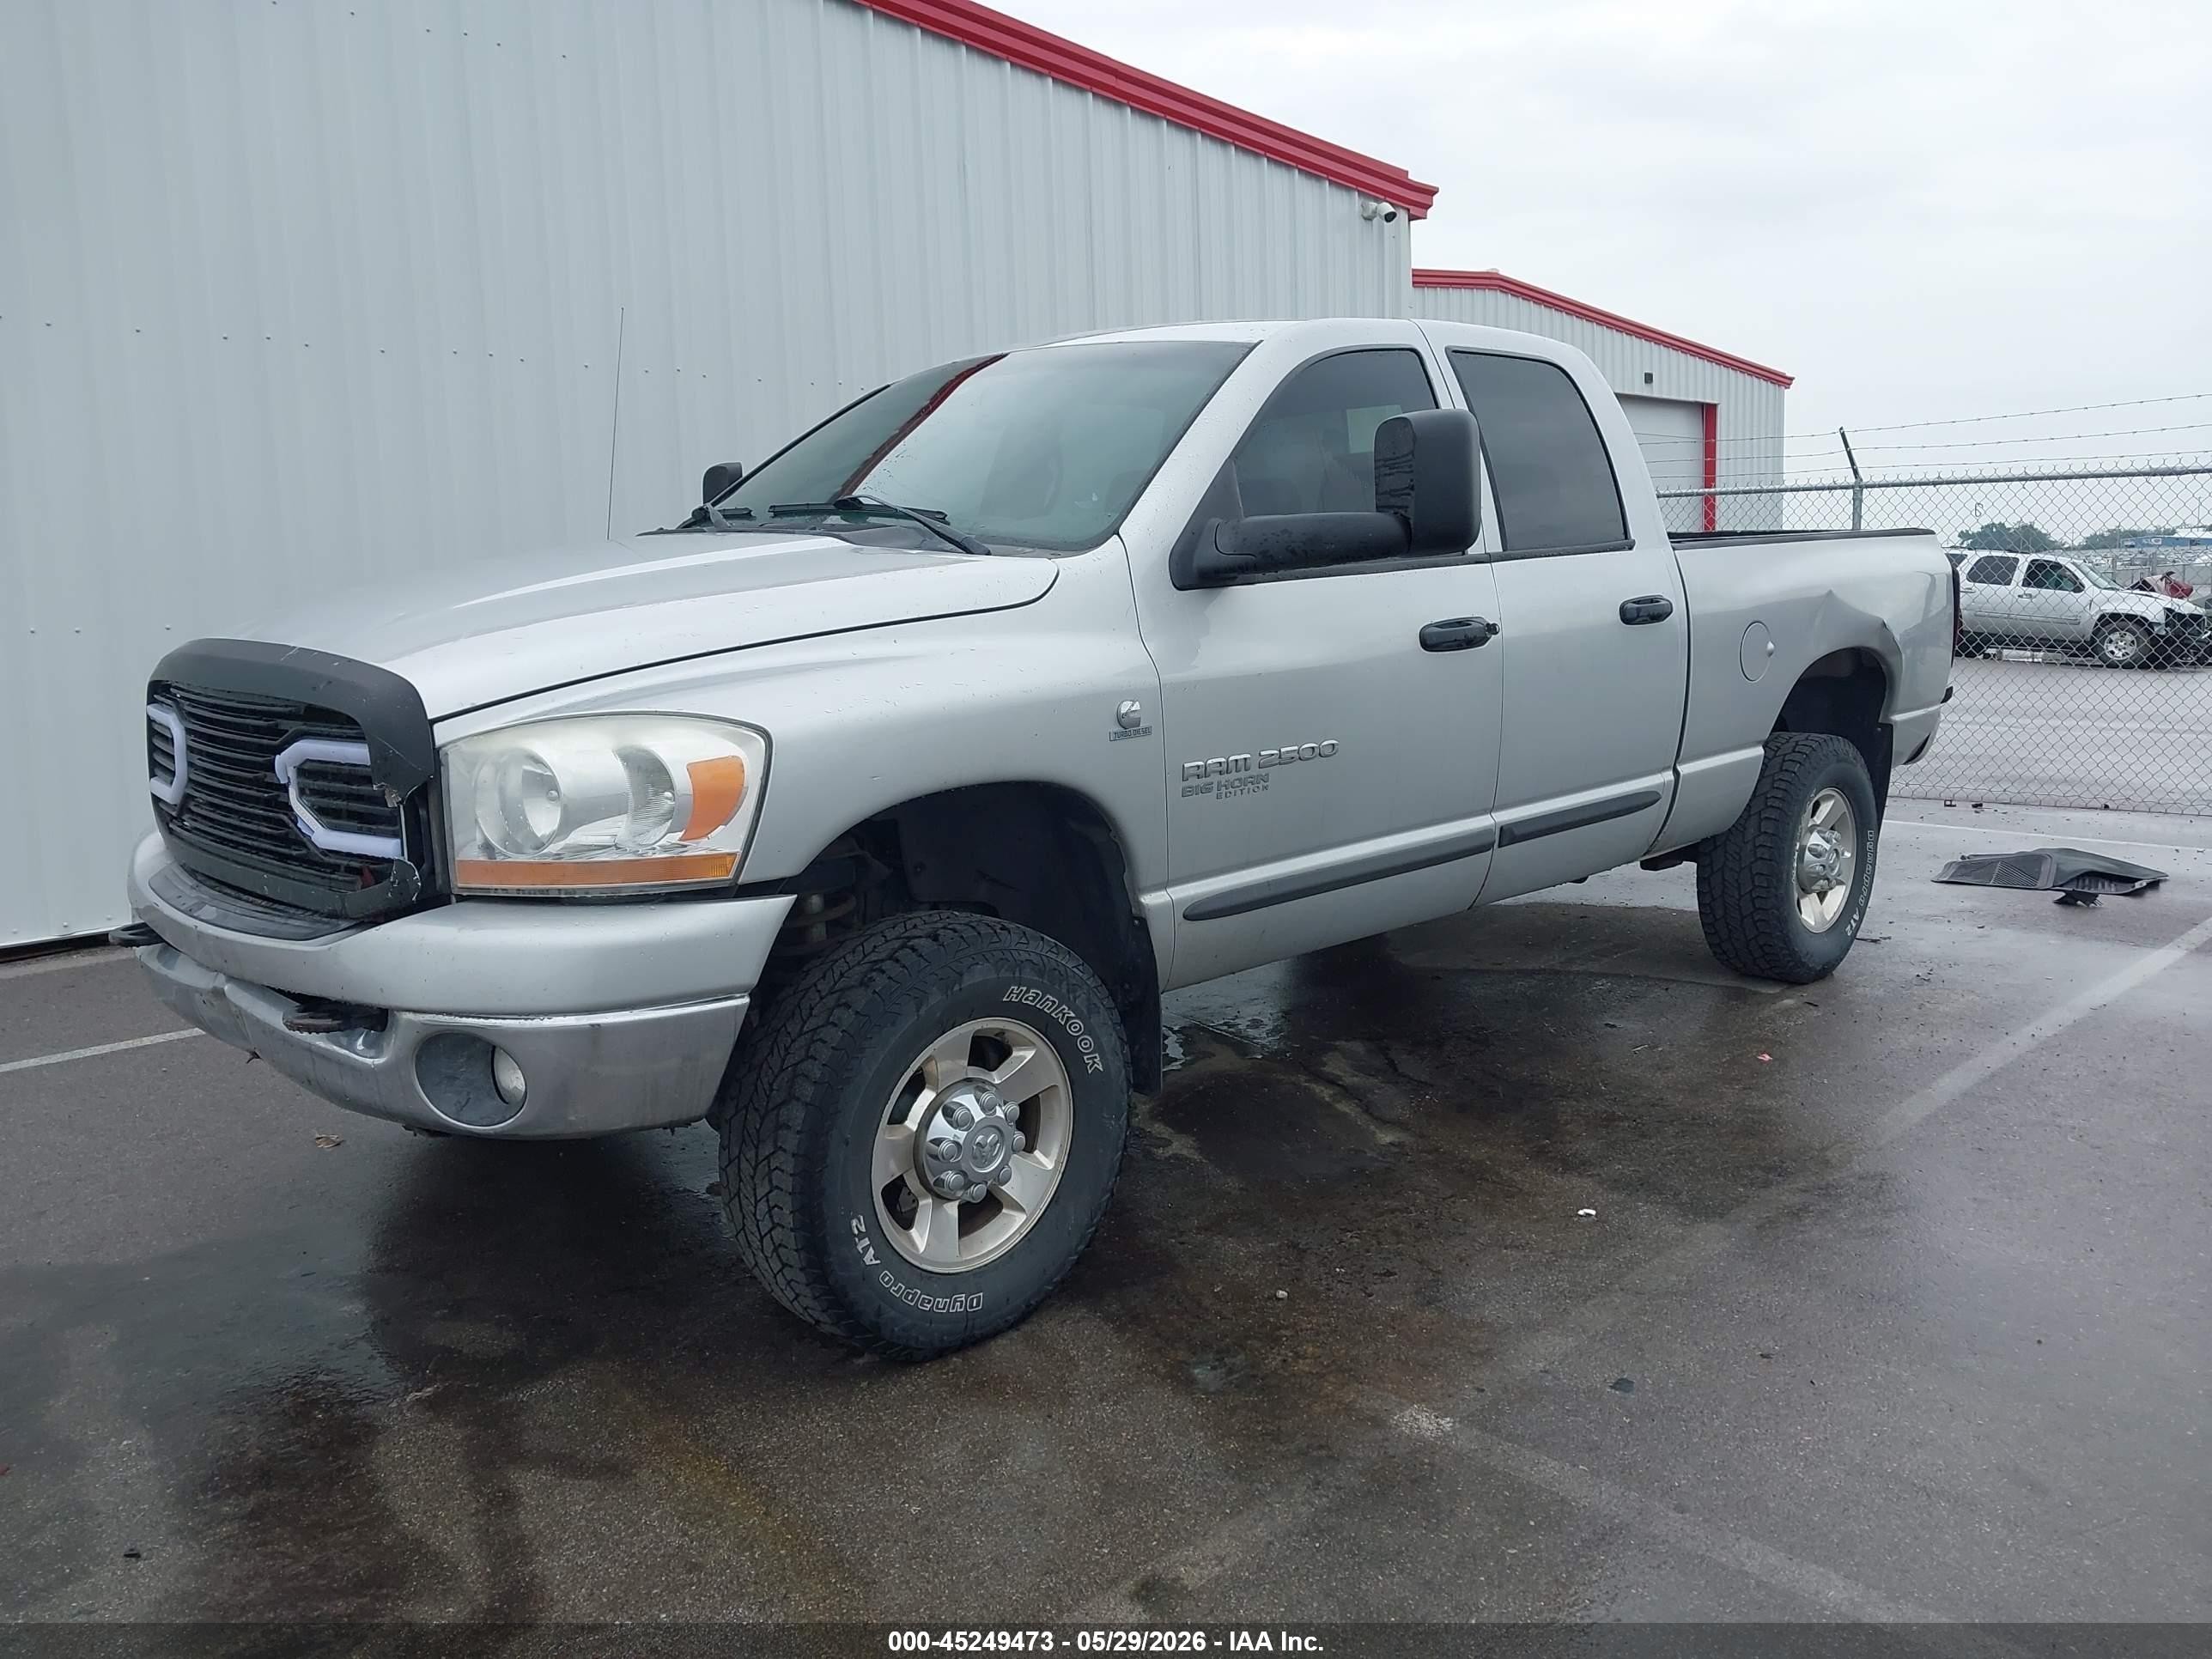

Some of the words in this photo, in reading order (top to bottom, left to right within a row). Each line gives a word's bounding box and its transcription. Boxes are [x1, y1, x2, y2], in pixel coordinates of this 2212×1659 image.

[1182, 753, 1251, 782] RAM
[1259, 739, 1340, 769] 2500
[1182, 781, 1214, 798] BIG
[1216, 773, 1270, 792] HORN
[1216, 783, 1270, 800] EDITION
[878, 1270, 983, 1312] Dynapro
